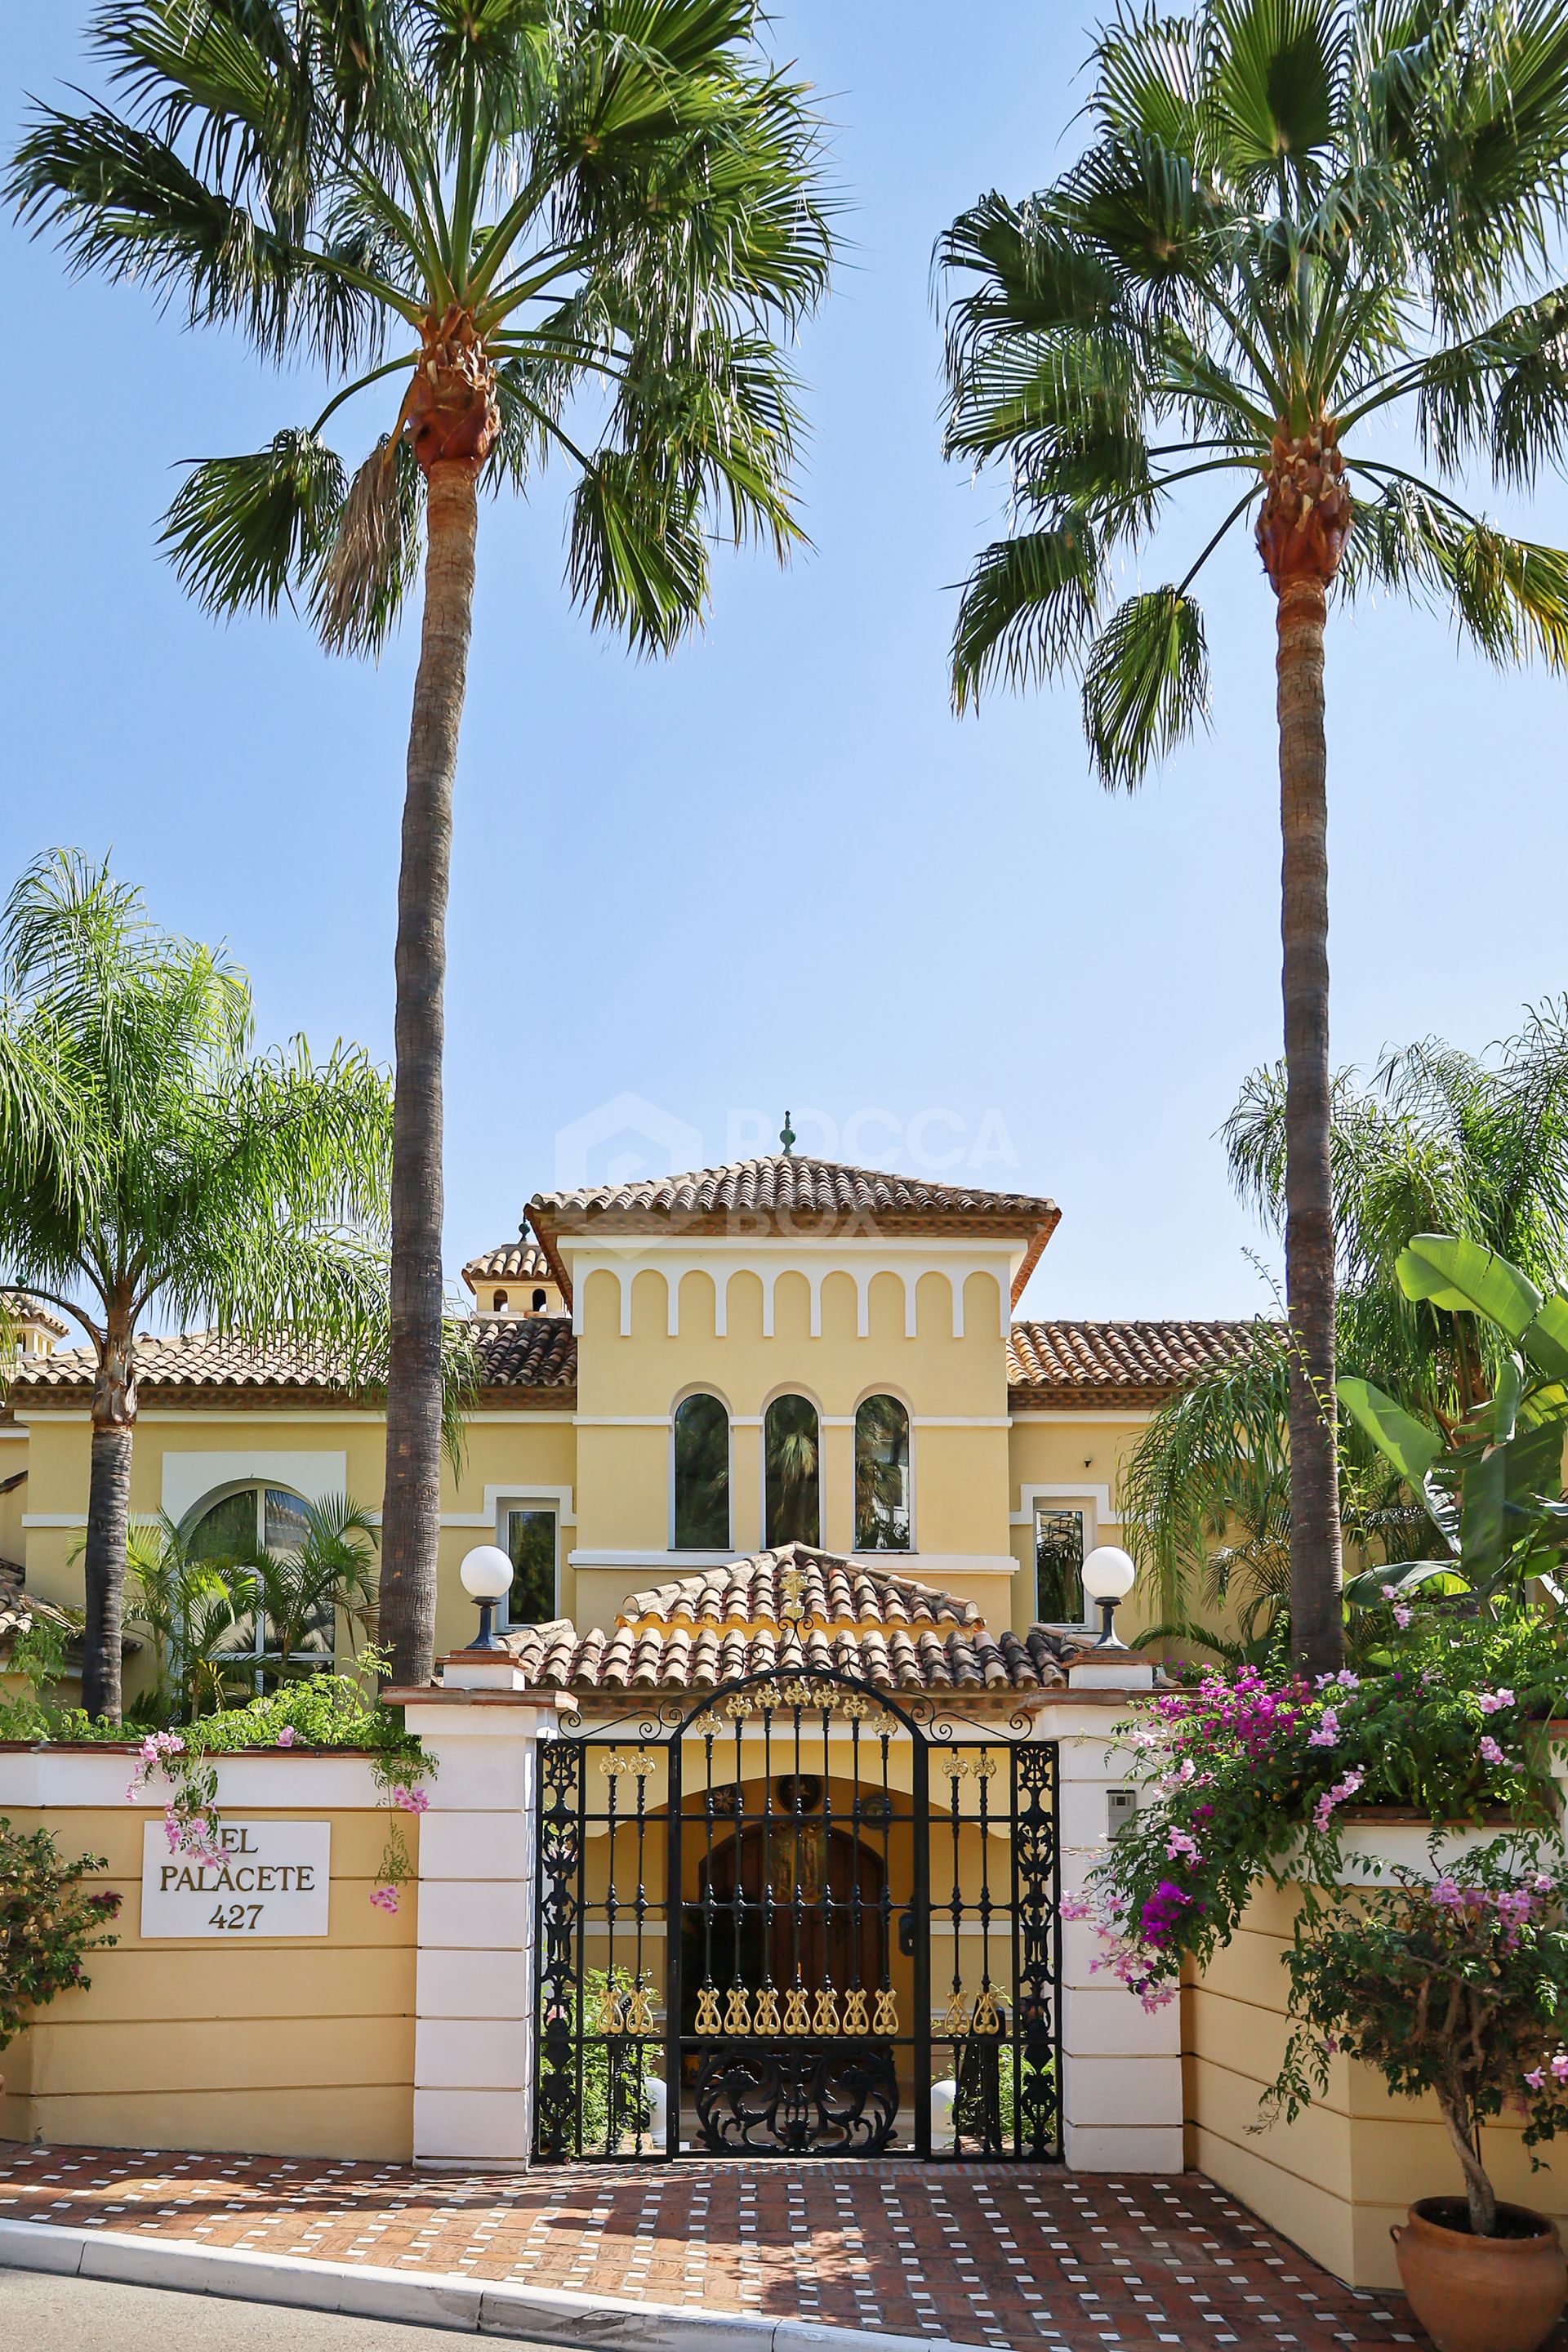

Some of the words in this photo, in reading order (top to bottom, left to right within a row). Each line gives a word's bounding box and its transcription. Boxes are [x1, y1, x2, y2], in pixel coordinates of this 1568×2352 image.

[220, 1829, 259, 1853] EL
[159, 1865, 315, 1891] PALACETE
[208, 1904, 265, 1930] 427
